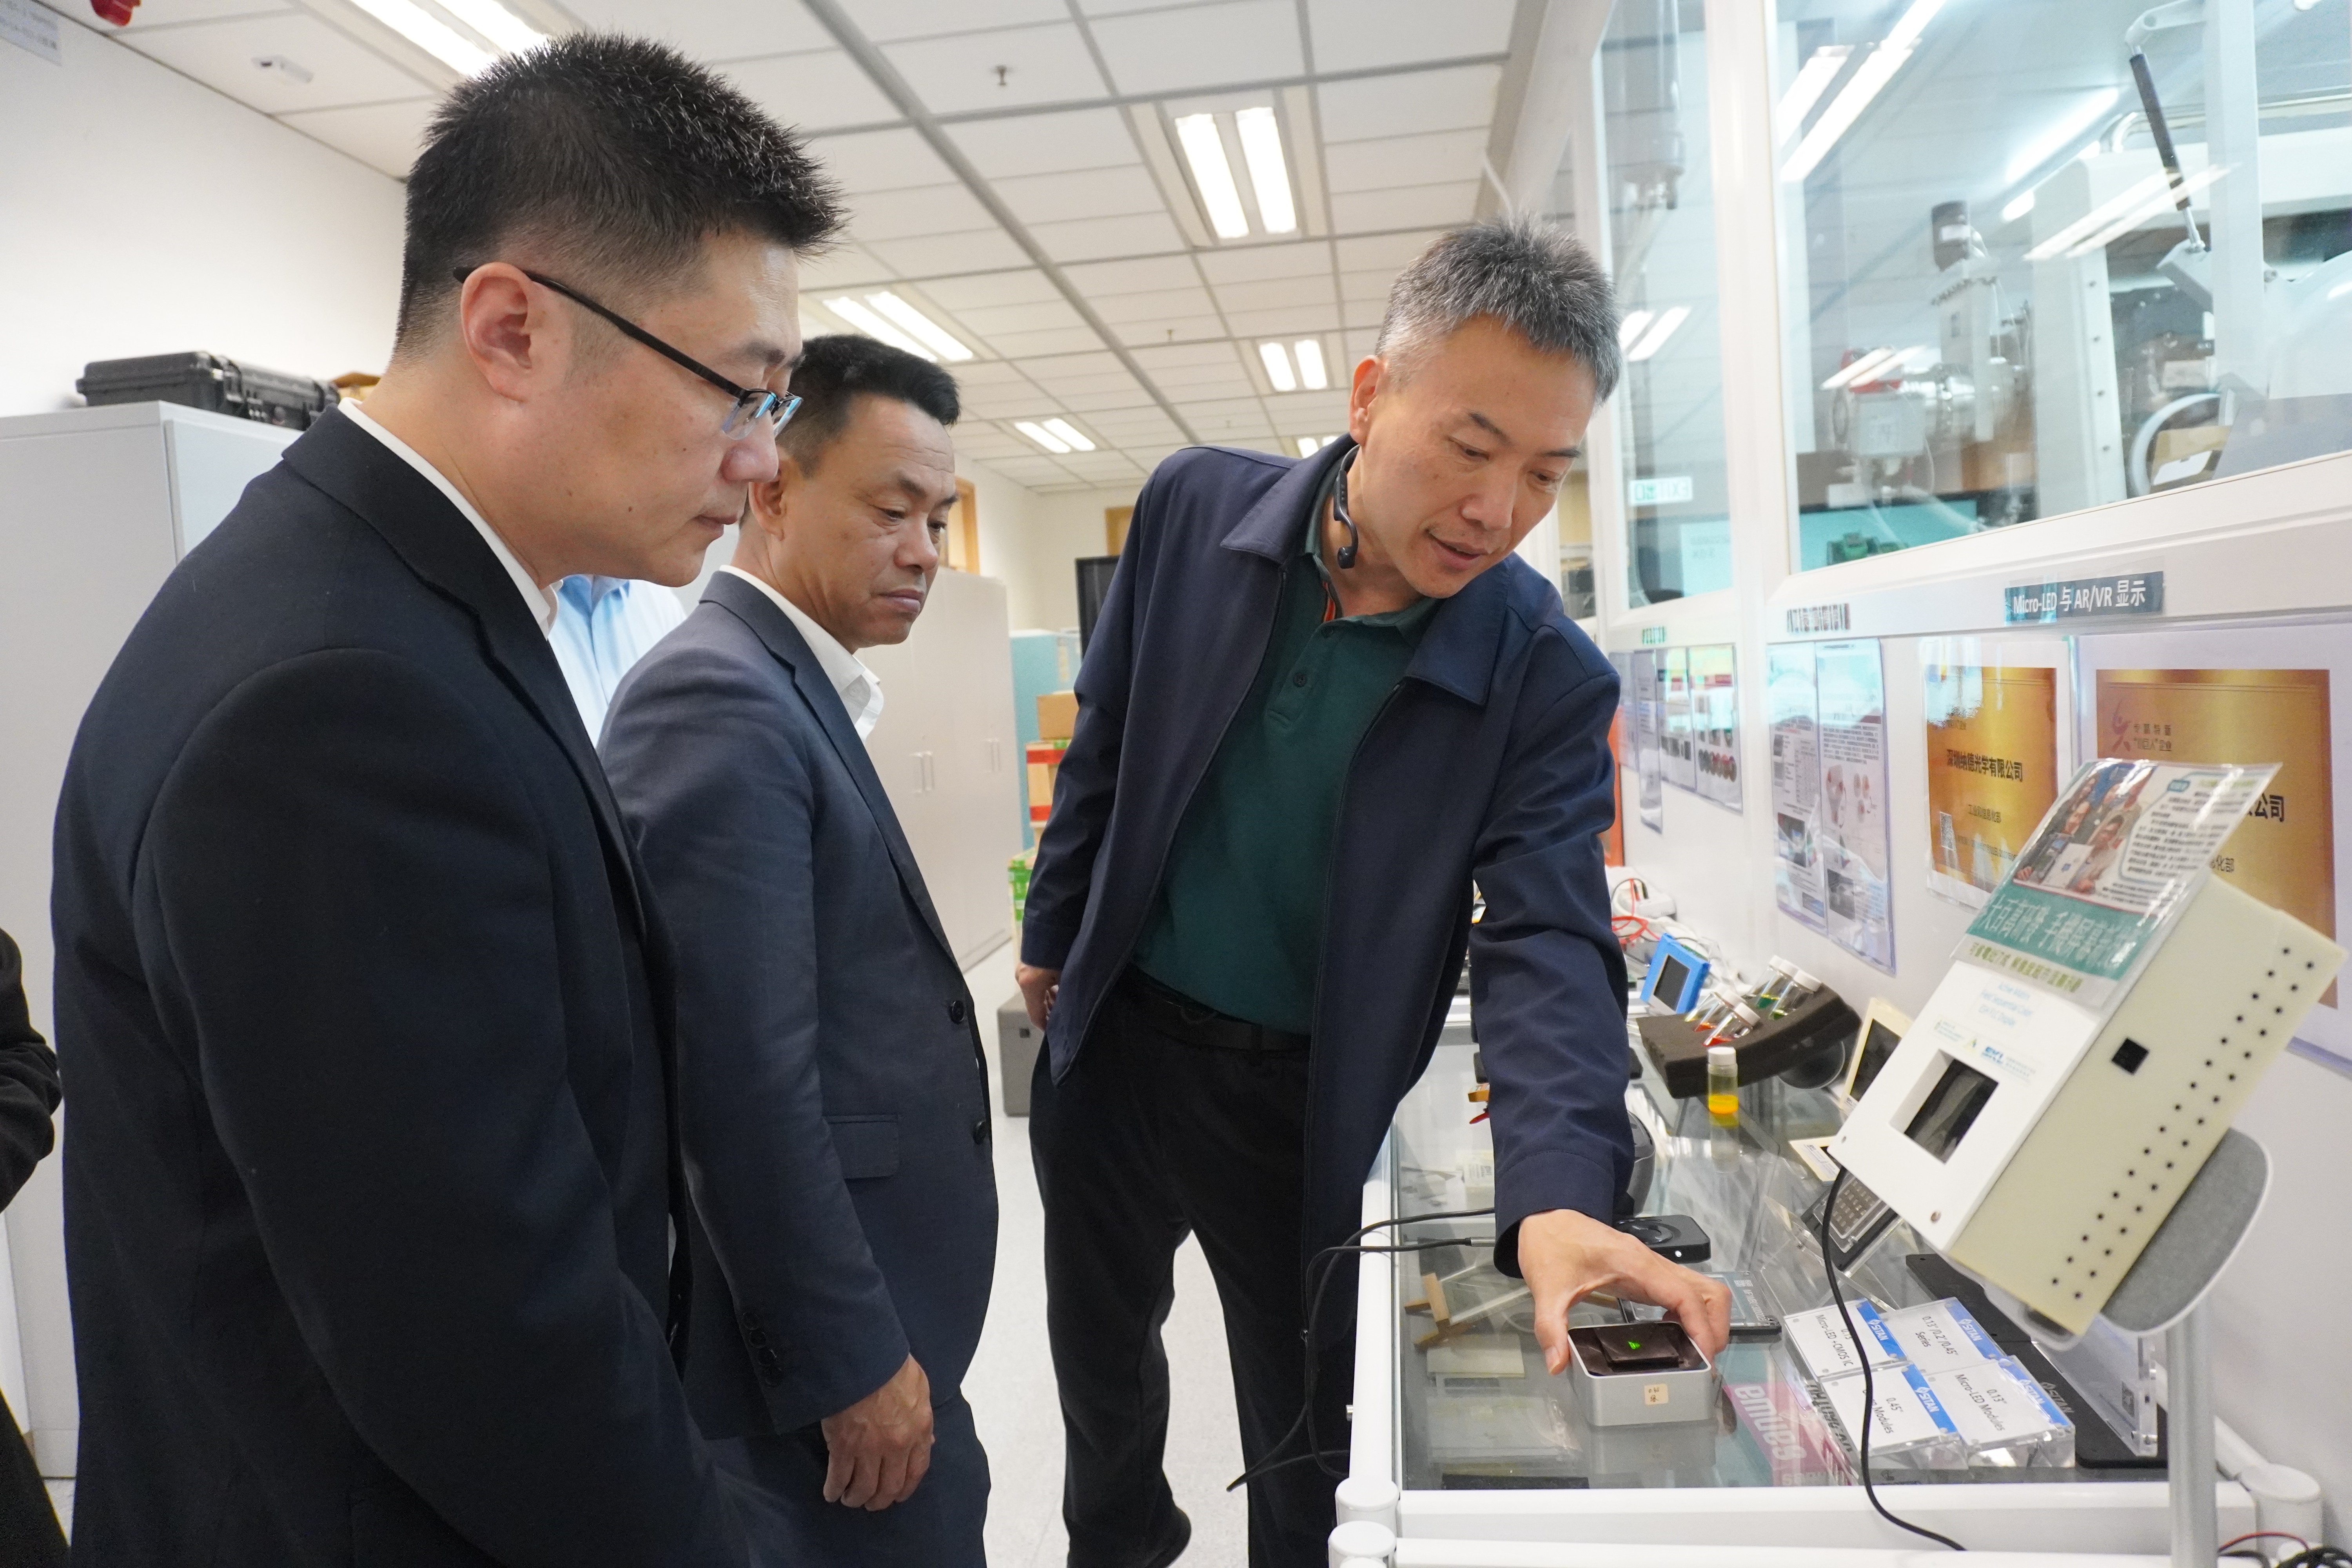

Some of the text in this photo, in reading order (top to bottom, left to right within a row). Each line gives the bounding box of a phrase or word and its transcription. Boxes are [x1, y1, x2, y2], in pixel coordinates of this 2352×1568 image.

[2013, 579, 2146, 614] Micro-LED 与 AR/VR 显示
[2249, 793, 2285, 822] 公司
[1815, 1314, 1837, 1339] Micro-LED
[1871, 1325, 1889, 1341] SITAN
[1915, 1331, 1931, 1347] Series
[1962, 1324, 1983, 1341] SITAN
[1918, 1393, 1940, 1413] SITAN
[1955, 1374, 2005, 1431] Micro-LED Modules
[1871, 1406, 1894, 1434] Modules
